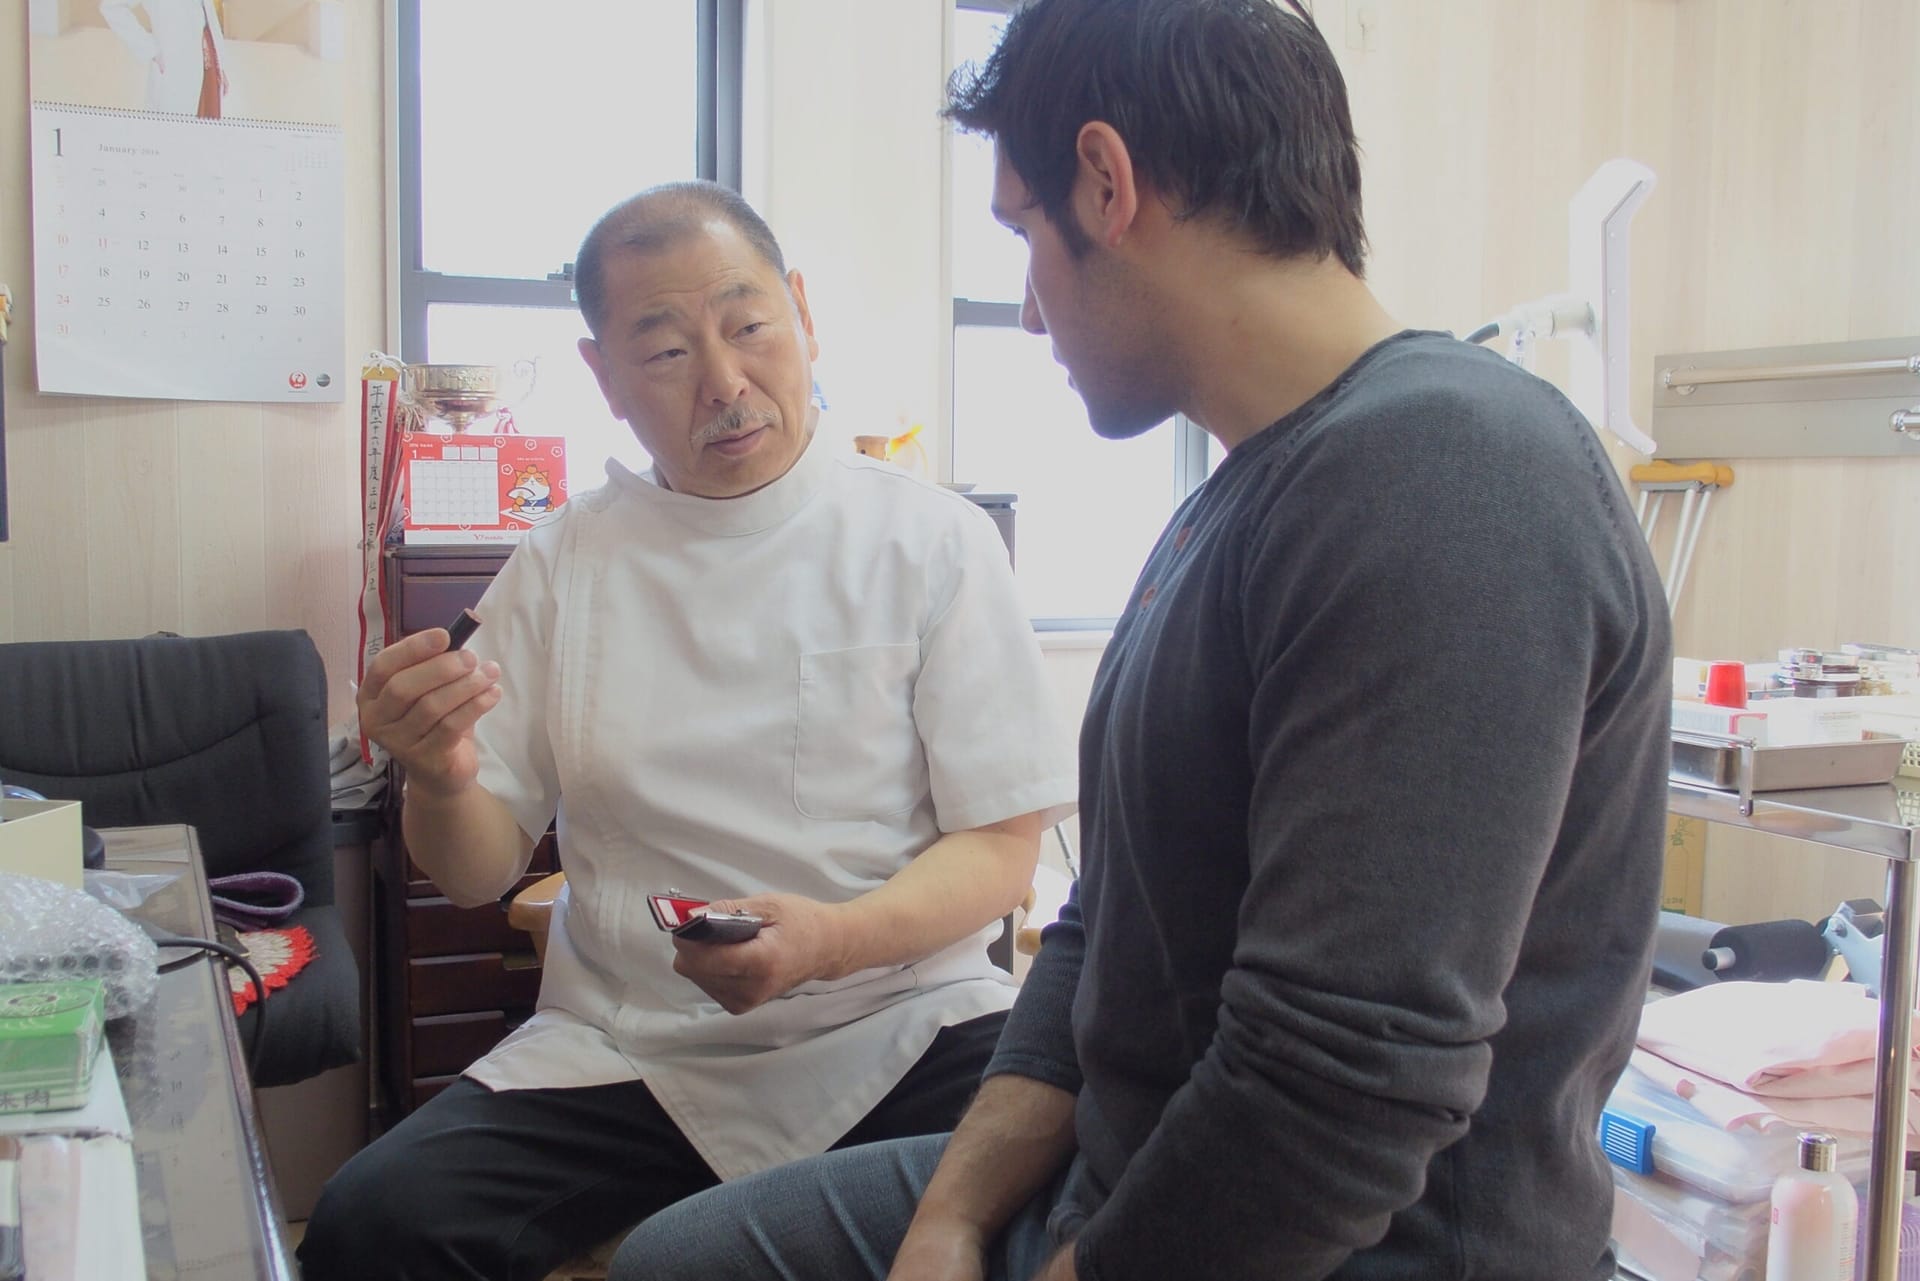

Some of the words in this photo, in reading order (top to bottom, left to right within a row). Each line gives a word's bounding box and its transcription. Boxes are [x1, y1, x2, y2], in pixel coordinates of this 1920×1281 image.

[53, 127, 64, 157] 1
[97, 143, 136, 156] January
[56, 234, 69, 246] 10
[97, 237, 109, 248] 11
[137, 240, 149, 251] 12
[177, 242, 189, 253] 13
[216, 245, 229, 256] 14
[255, 246, 267, 257] 15
[293, 248, 306, 259] 16
[57, 265, 69, 276] 17
[98, 266, 110, 277] 18
[138, 270, 150, 280] 19
[177, 272, 189, 283] 20
[216, 274, 228, 285] 21
[255, 275, 268, 286] 22
[293, 277, 305, 288] 23
[57, 294, 70, 306] 24
[98, 296, 110, 307] 25
[138, 299, 150, 310] 26
[177, 301, 190, 312] 27
[217, 303, 229, 314] 28
[255, 304, 268, 315] 29
[293, 306, 306, 317] 30
[57, 324, 69, 335] 31
